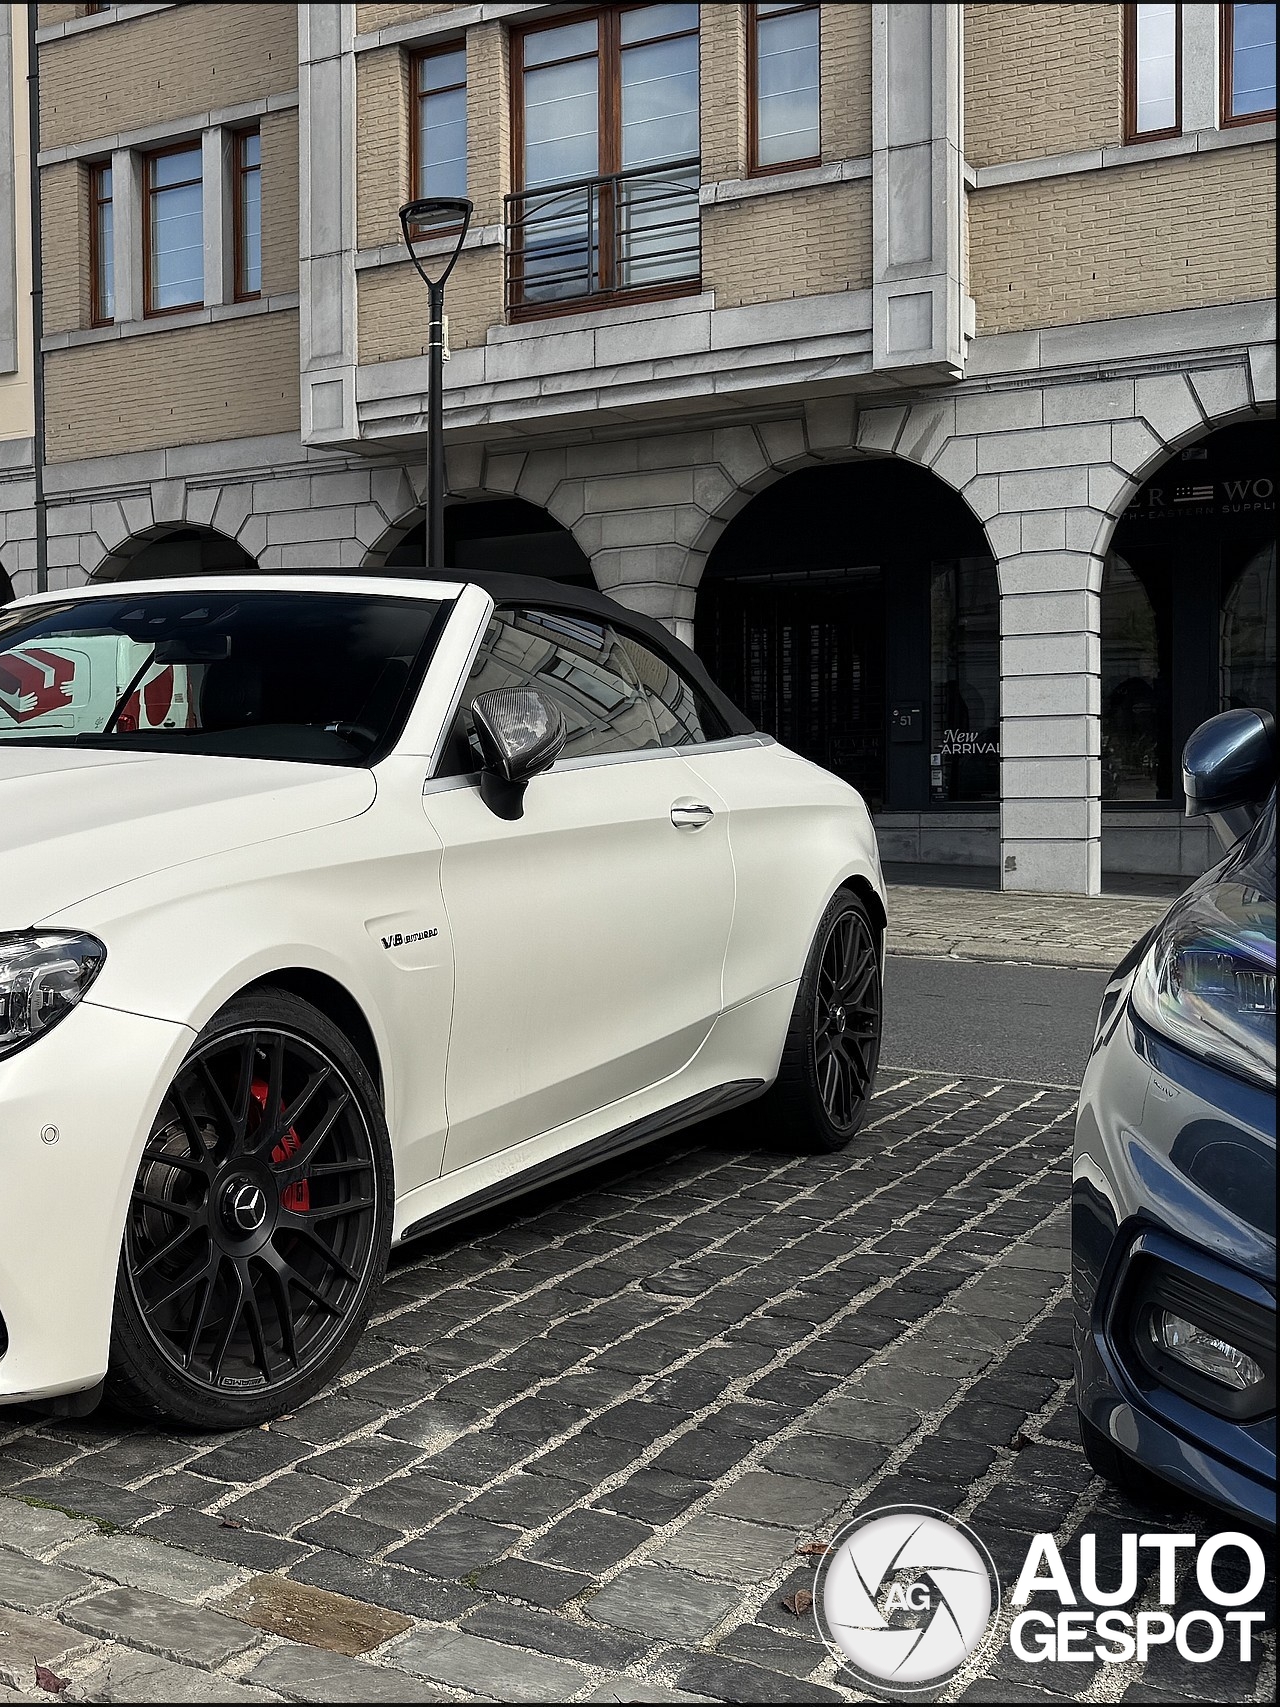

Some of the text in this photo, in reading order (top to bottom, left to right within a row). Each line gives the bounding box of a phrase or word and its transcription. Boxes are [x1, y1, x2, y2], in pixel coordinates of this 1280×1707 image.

[900, 715, 912, 726] 51
[943, 728, 979, 744] New
[381, 933, 404, 950] V8
